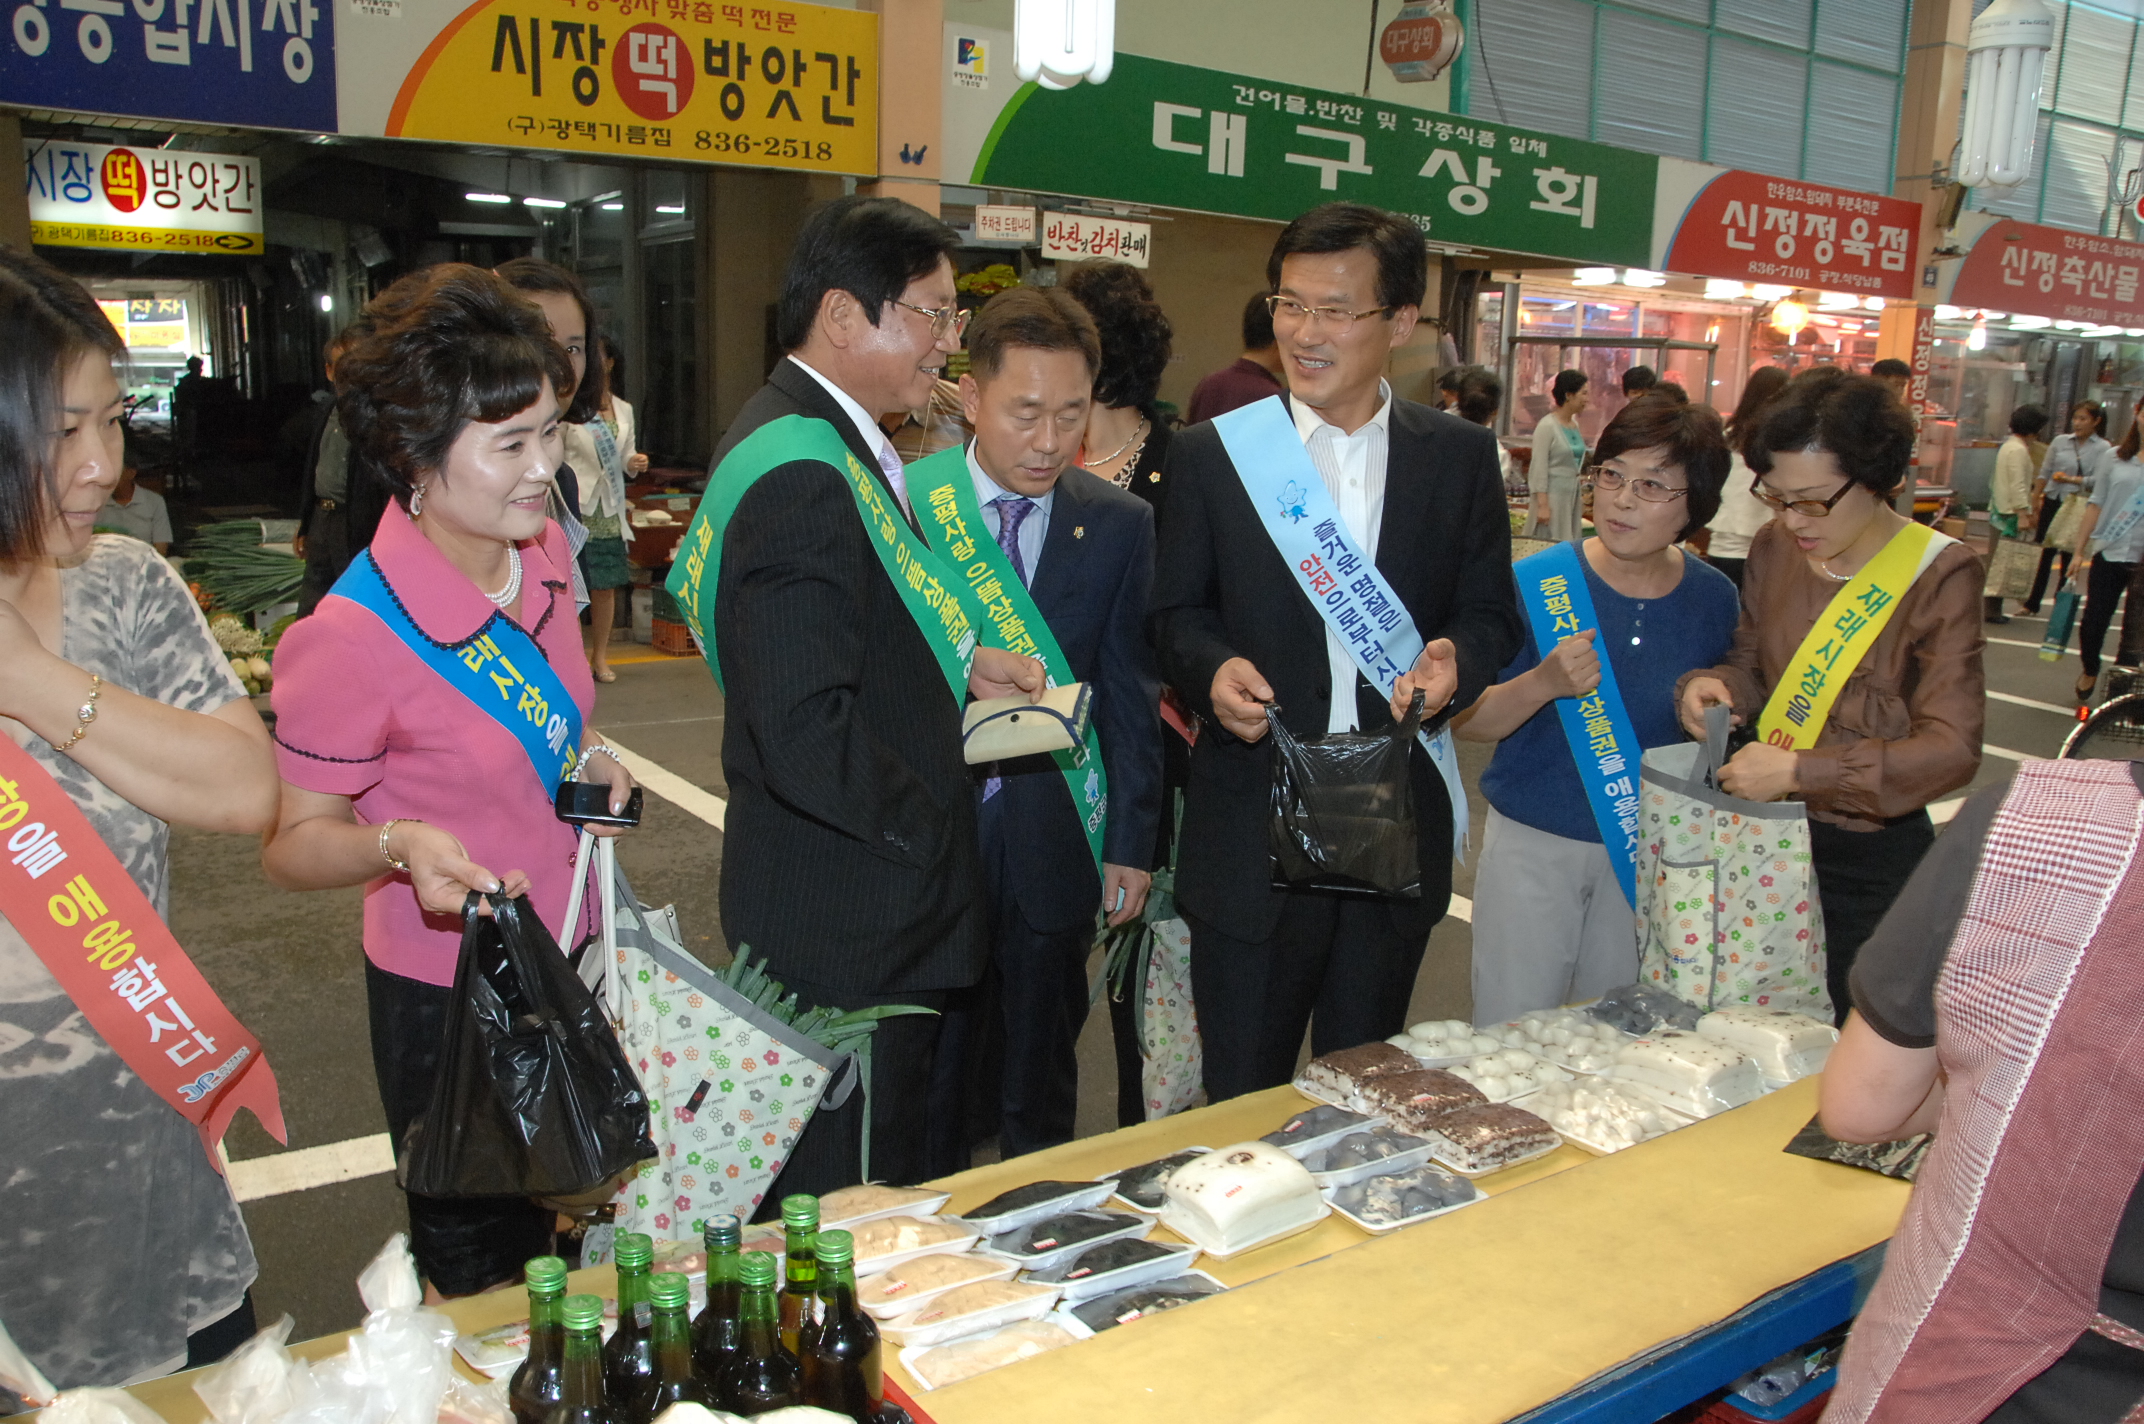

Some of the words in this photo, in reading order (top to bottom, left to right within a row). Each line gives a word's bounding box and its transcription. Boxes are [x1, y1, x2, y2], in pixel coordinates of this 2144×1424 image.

[491, 14, 606, 106] 시장
[628, 32, 677, 113] 떡
[704, 38, 861, 127] 방앗간
[694, 130, 833, 161] 836-2518
[1376, 110, 1398, 132] 및
[1412, 117, 1498, 150] 각종식품
[1509, 135, 1549, 158] 일체
[105, 153, 139, 209] 떡
[152, 159, 255, 214] 방앗간
[112, 230, 215, 247] 836-2518
[980, 215, 1002, 231] 주차권
[1004, 216, 1032, 234] 드립니다
[1721, 200, 1909, 272] 신정정육점
[1748, 260, 1811, 281] 836-7101
[2000, 246, 2140, 302] 신정축산물
[846, 451, 896, 546] 증평사랑
[928, 483, 977, 564] 증평사랑
[1299, 553, 1385, 664] 안전으로부터
[1313, 518, 1362, 577] 즐거운
[1349, 573, 1403, 633] 명절은
[1539, 574, 1580, 645] 증평사
[1785, 583, 1894, 728] 재래시장을
[457, 633, 570, 757] 래시장을
[47, 873, 218, 1068] 애용합시다
